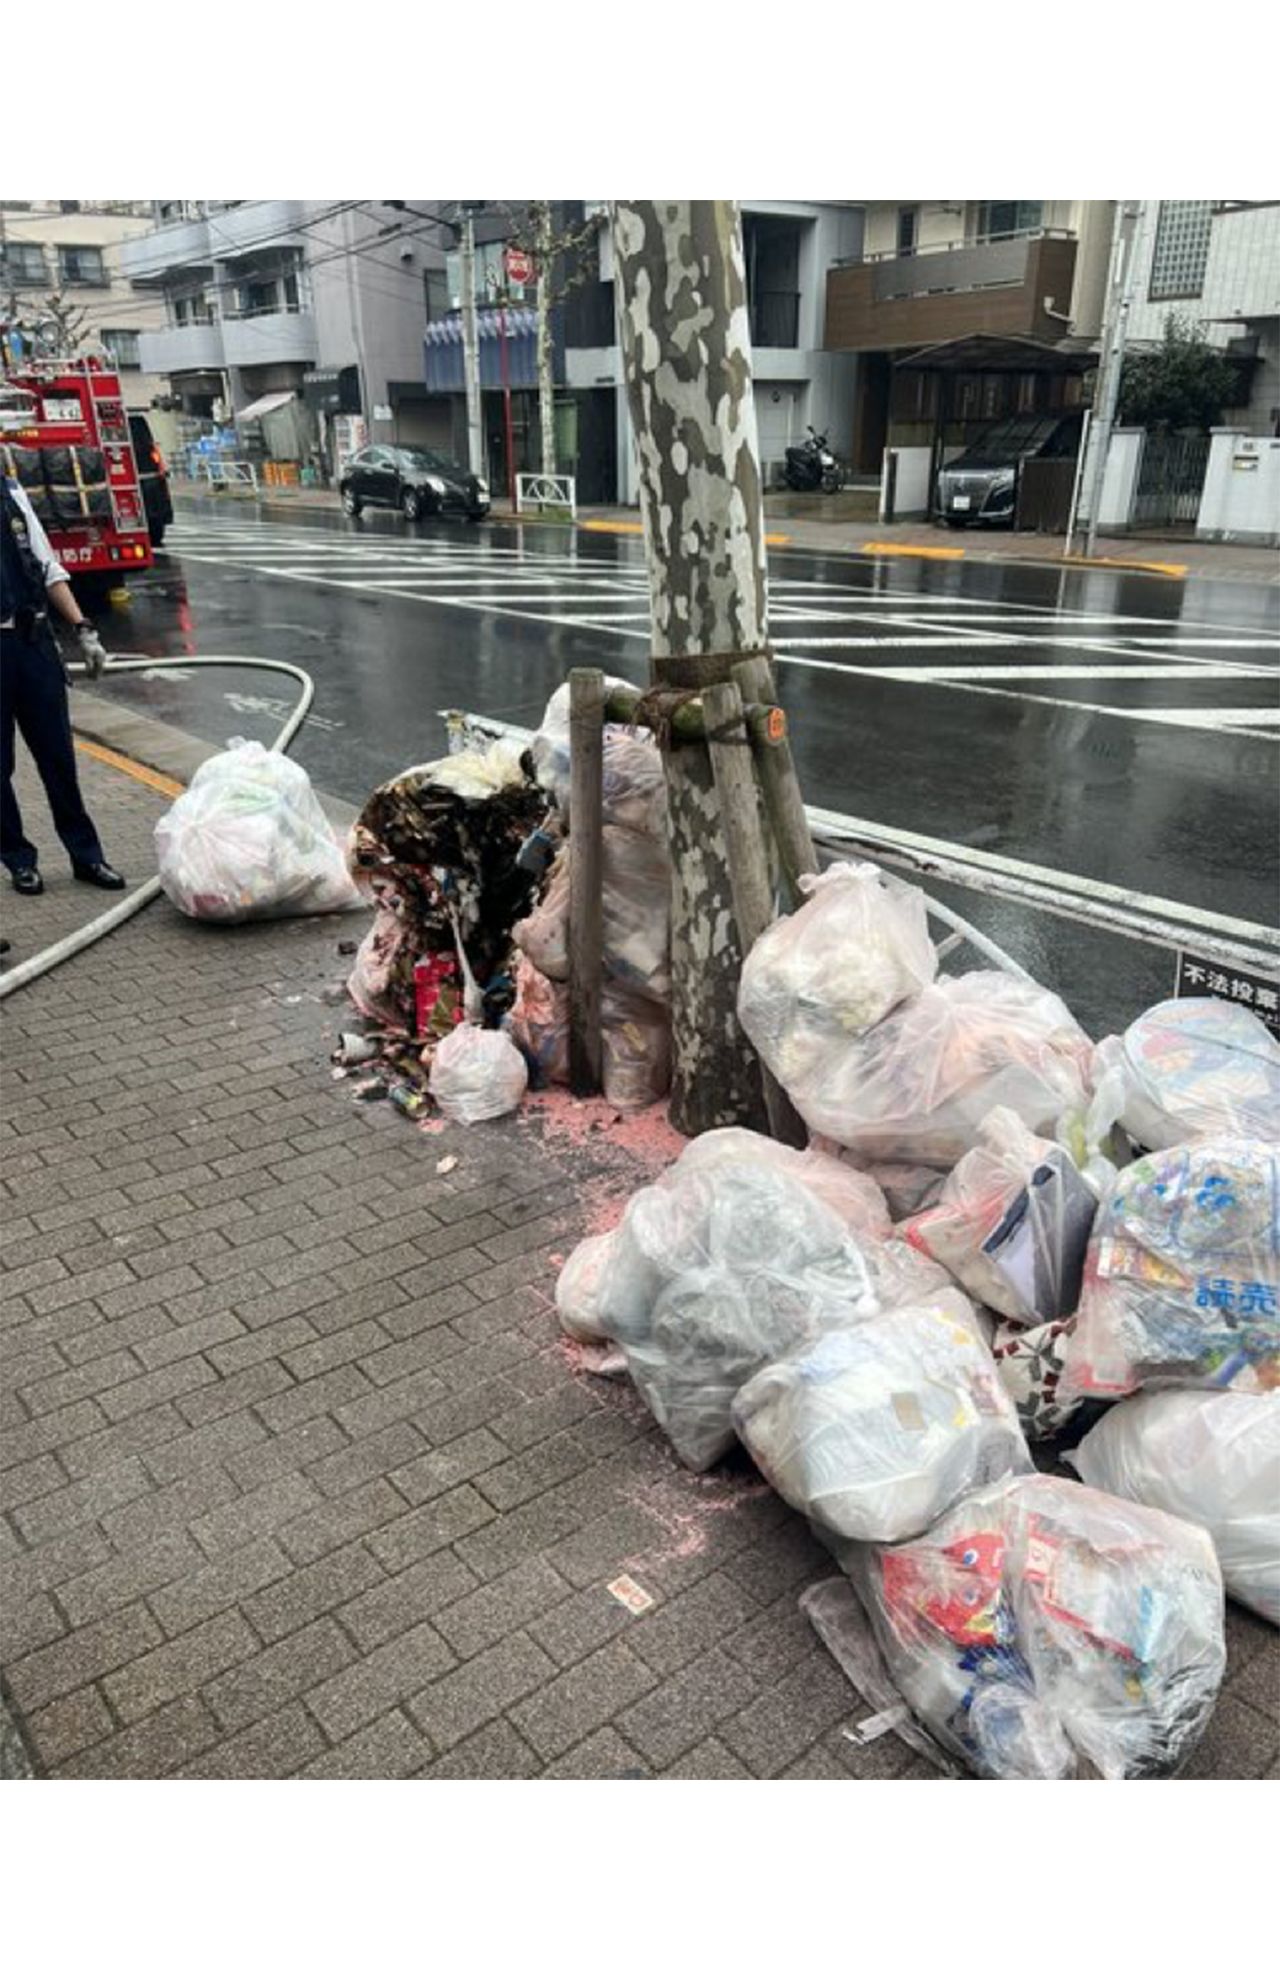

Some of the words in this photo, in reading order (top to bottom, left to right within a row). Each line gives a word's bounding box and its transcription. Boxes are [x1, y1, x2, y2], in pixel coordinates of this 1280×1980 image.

[1184, 963, 1279, 1010] 不法投棄
[1196, 1275, 1277, 1316] 読売
